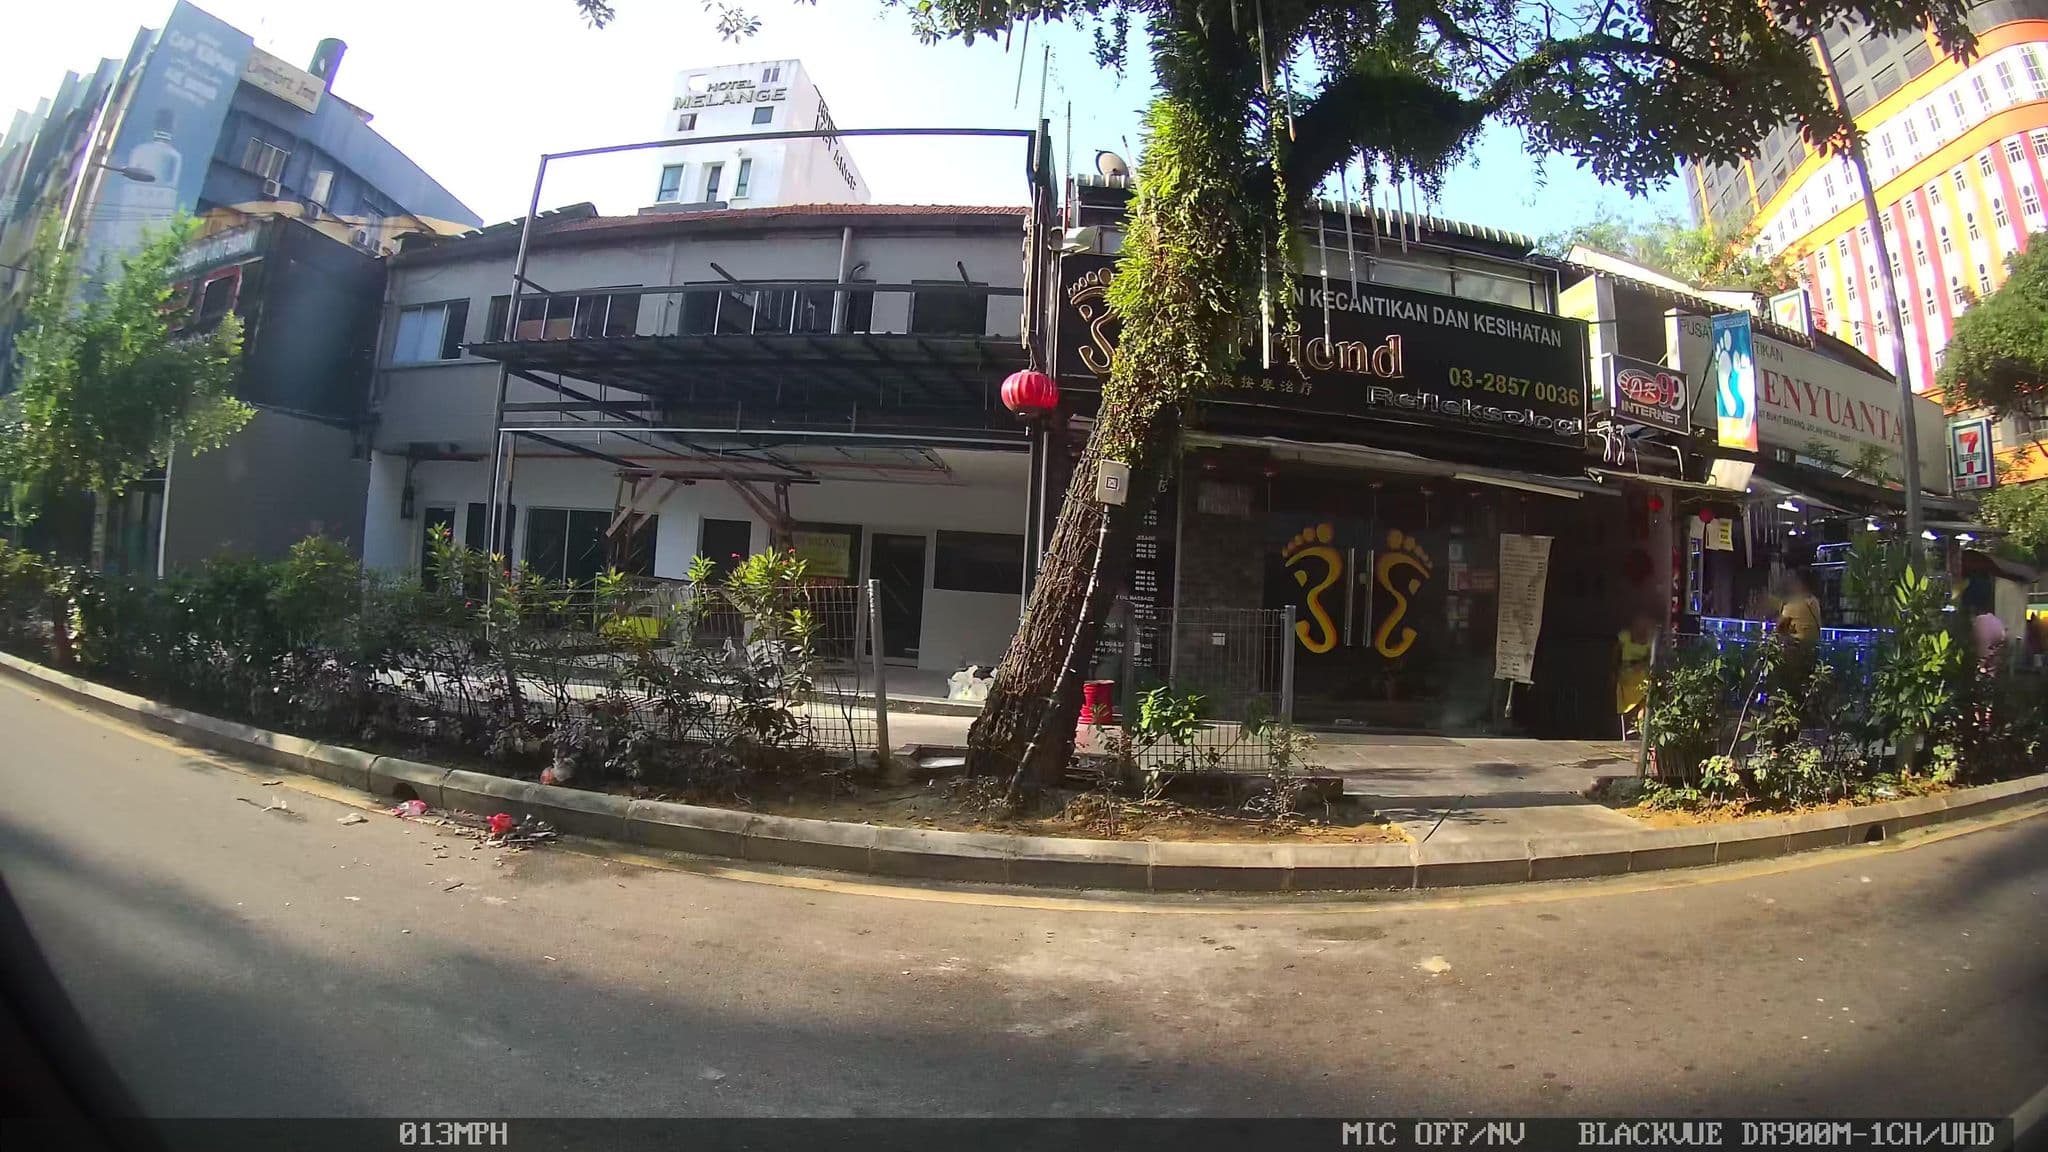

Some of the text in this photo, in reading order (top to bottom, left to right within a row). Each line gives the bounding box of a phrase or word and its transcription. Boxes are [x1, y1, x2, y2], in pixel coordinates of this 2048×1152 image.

[673, 87, 788, 111] MELANGE
[706, 80, 756, 93] HOTEL
[1310, 287, 1428, 323] KECANTIKAN
[1433, 306, 1470, 330] DAN
[1474, 313, 1562, 348] KESIHATAN
[1680, 318, 1711, 340] PUSA
[1450, 367, 1580, 407] 03-2857 0036
[1367, 384, 1583, 437] Refleksologi
[1621, 399, 1681, 426] INTERNET
